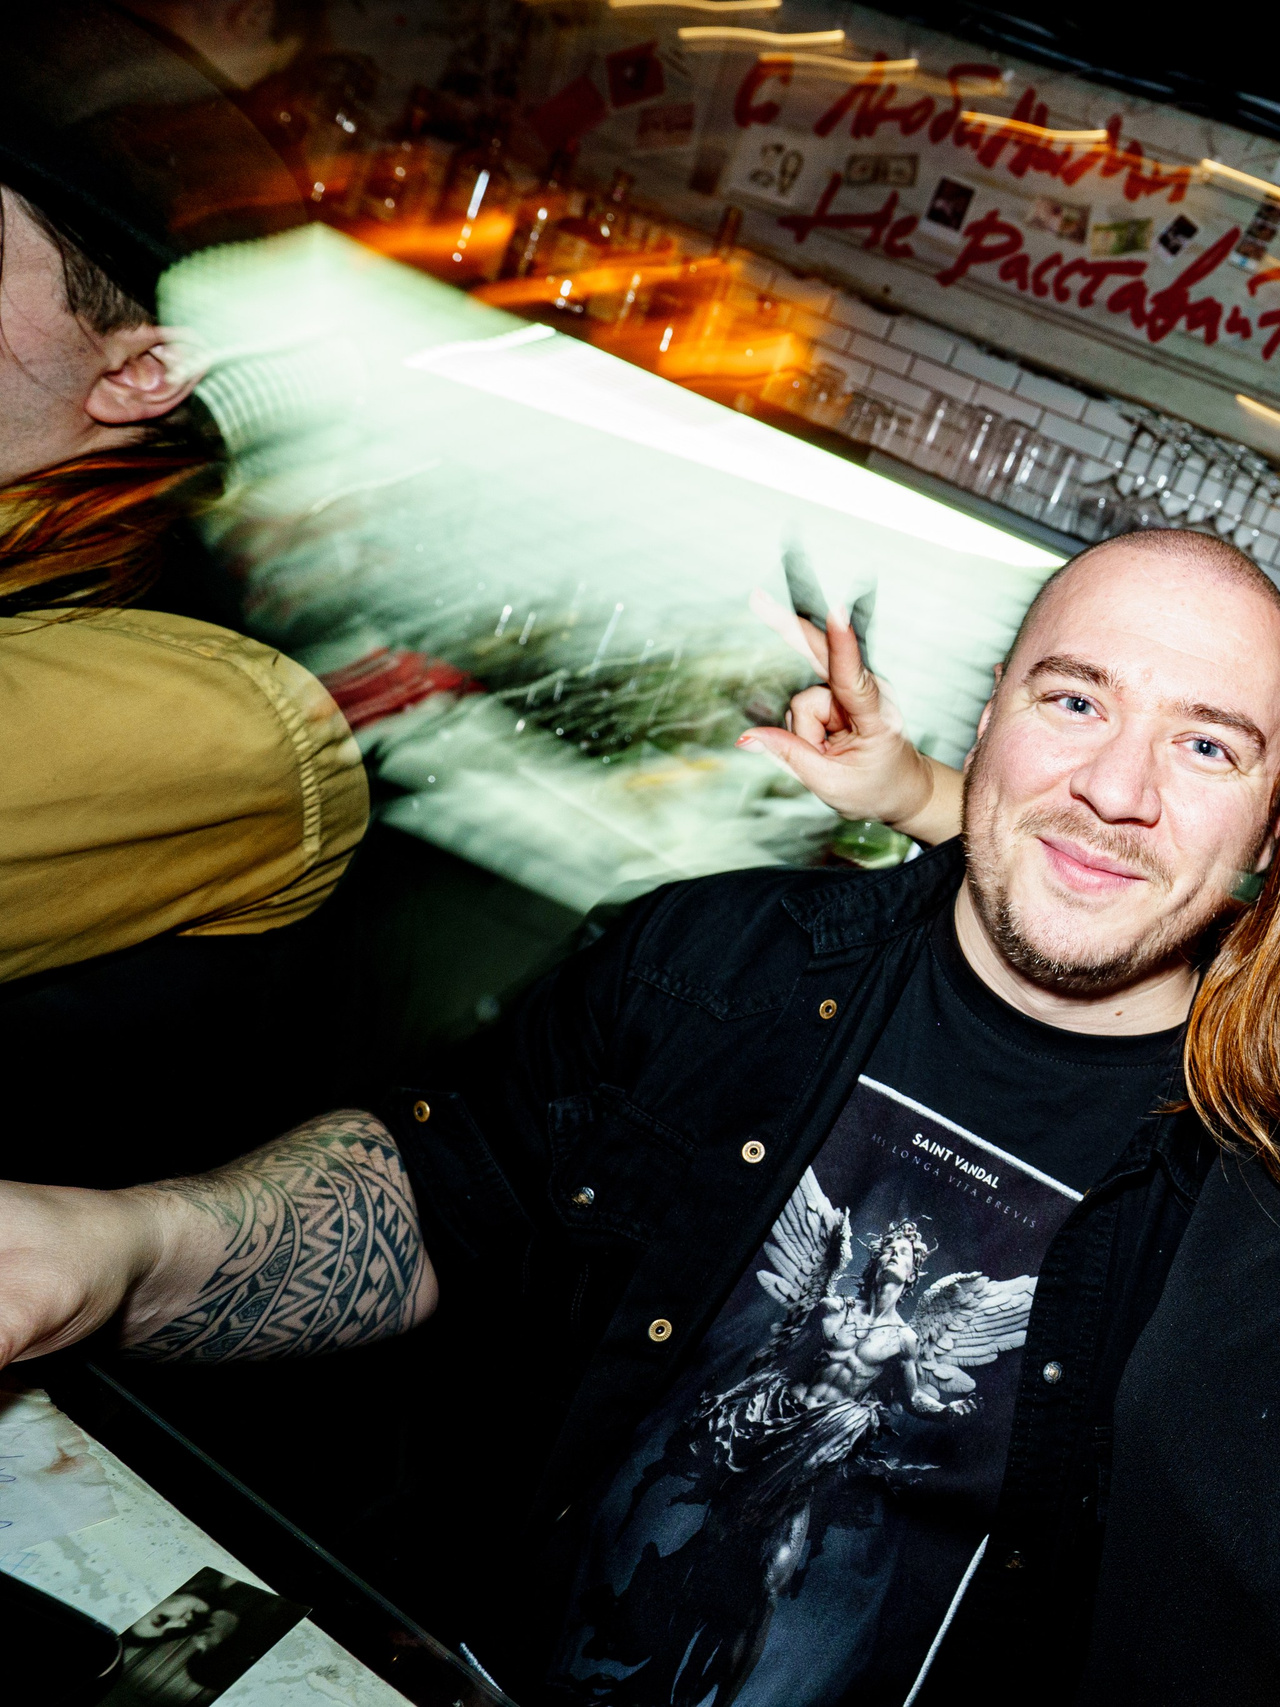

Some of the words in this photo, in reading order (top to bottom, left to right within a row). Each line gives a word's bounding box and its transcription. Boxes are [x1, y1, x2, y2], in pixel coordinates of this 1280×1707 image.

[892, 1145, 940, 1177] LONGA
[948, 1175, 977, 1198] VITA
[985, 1196, 1037, 1229] BREVIS
[912, 1133, 953, 1161] SAINT
[954, 1155, 1000, 1189] VANDAL
